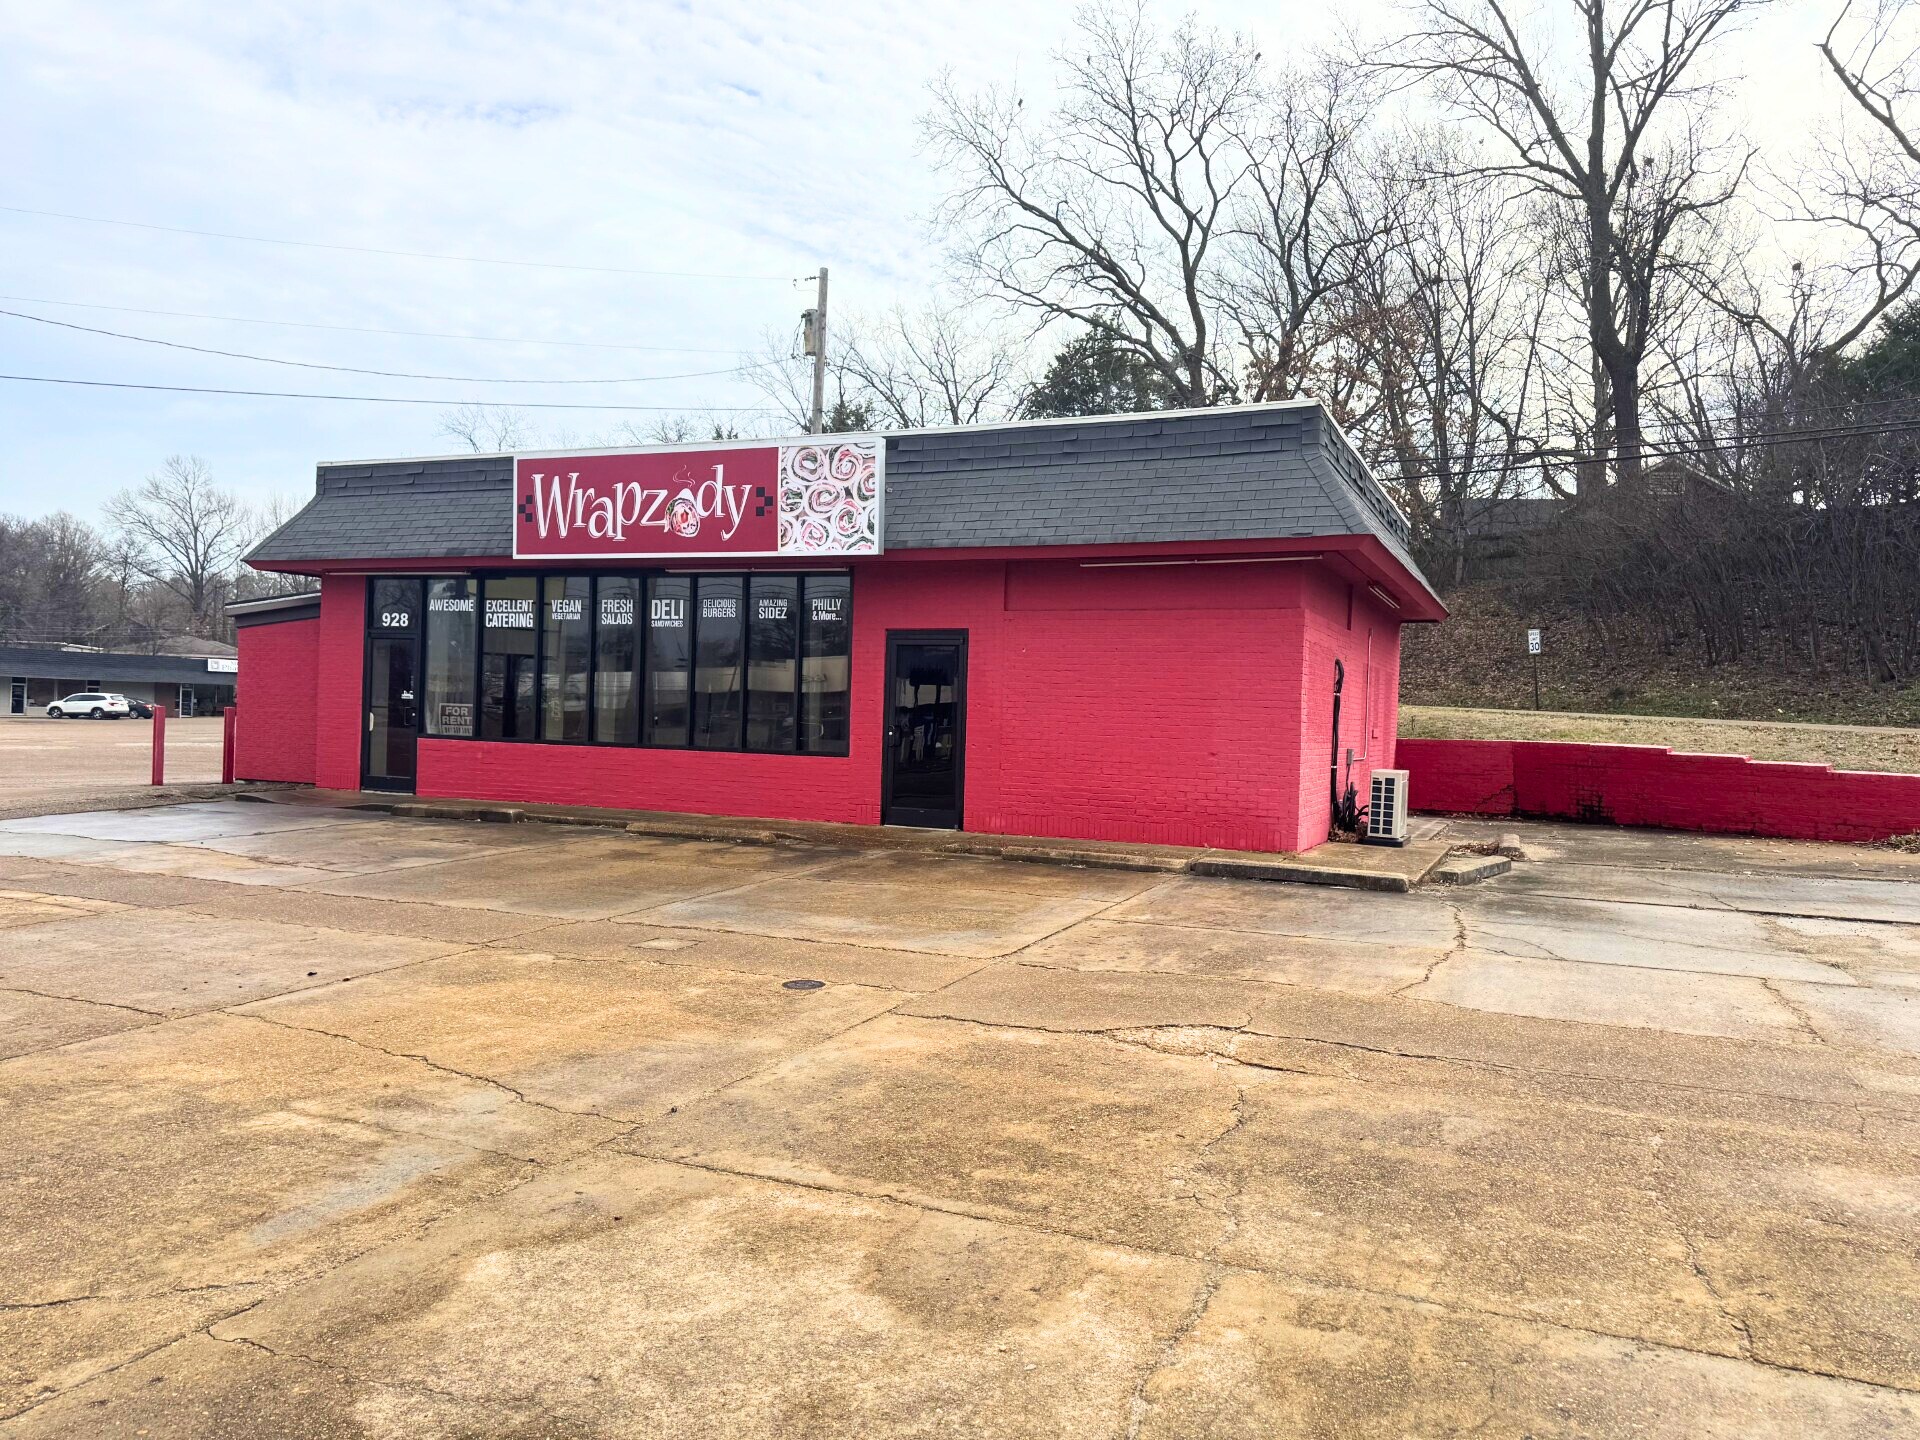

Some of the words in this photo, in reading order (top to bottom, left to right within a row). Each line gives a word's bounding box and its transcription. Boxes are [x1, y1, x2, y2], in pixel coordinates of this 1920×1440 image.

[429, 599, 474, 612] AWESOME
[486, 600, 534, 612] EXCELLENT
[551, 600, 582, 613] VEGAN
[601, 600, 633, 613] FRESH
[703, 599, 736, 608] DELICIOUS
[759, 599, 788, 607] AMAZING
[812, 599, 842, 611] PHILLY
[651, 600, 684, 620] DELI
[703, 608, 736, 618] BURGERS
[759, 607, 787, 619] SIDEZ
[382, 612, 409, 627] 928
[485, 613, 533, 628] CATERING
[601, 613, 633, 625] SALADS
[651, 620, 684, 628] SANDWICHES
[1530, 642, 1540, 651] 30
[445, 706, 468, 716] FOR
[441, 716, 473, 725] RENT
